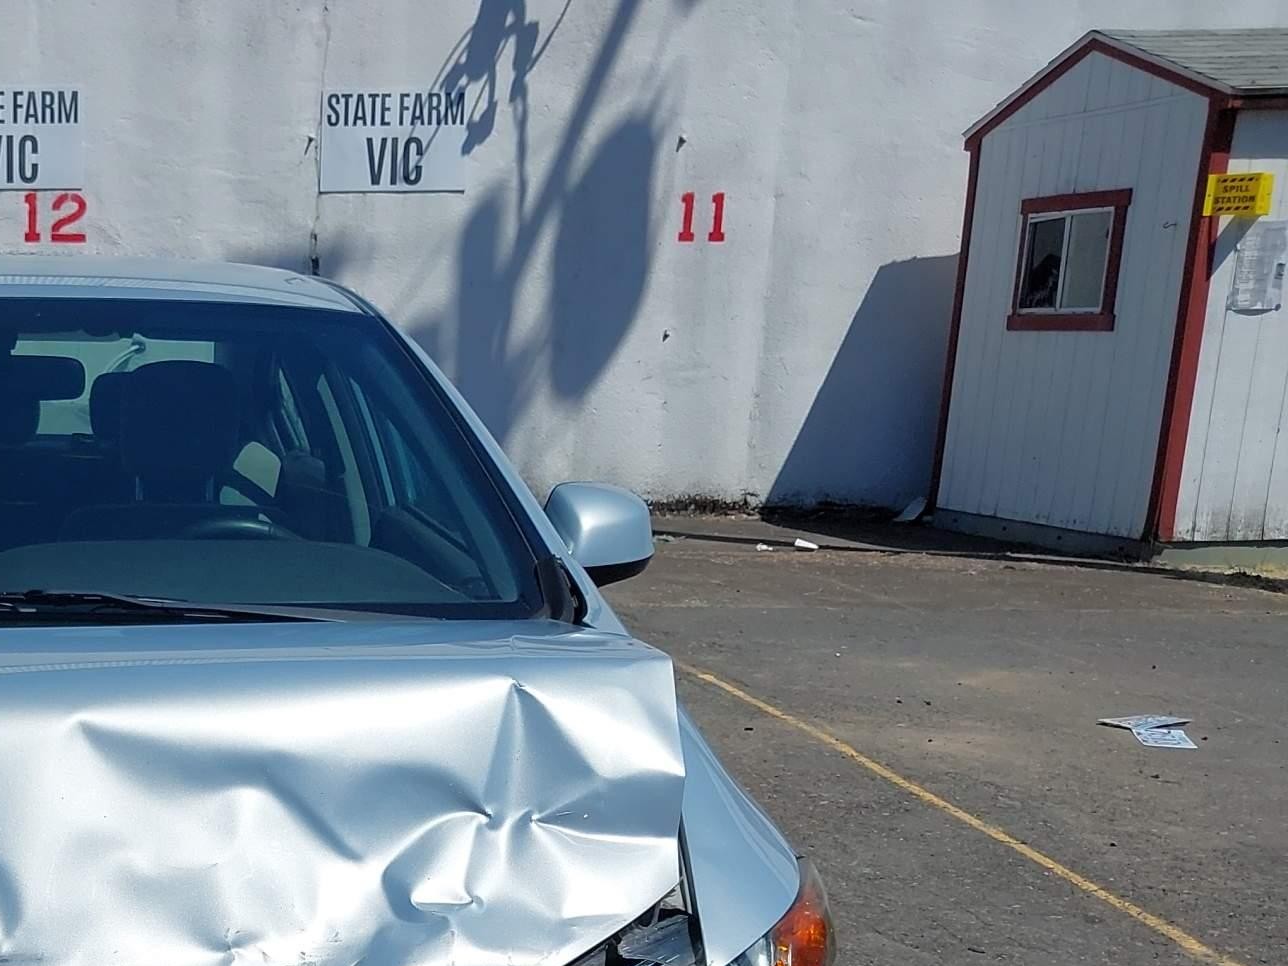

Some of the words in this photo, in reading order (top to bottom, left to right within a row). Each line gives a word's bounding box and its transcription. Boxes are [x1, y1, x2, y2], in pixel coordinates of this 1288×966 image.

[12, 90, 80, 124] FARM
[326, 93, 393, 127] STATE
[398, 92, 466, 127] FARM
[366, 136, 425, 186] VIC
[1214, 195, 1256, 205] STATION
[1222, 184, 1250, 194] SPILL
[23, 191, 88, 245] 12
[675, 191, 726, 245] 11
